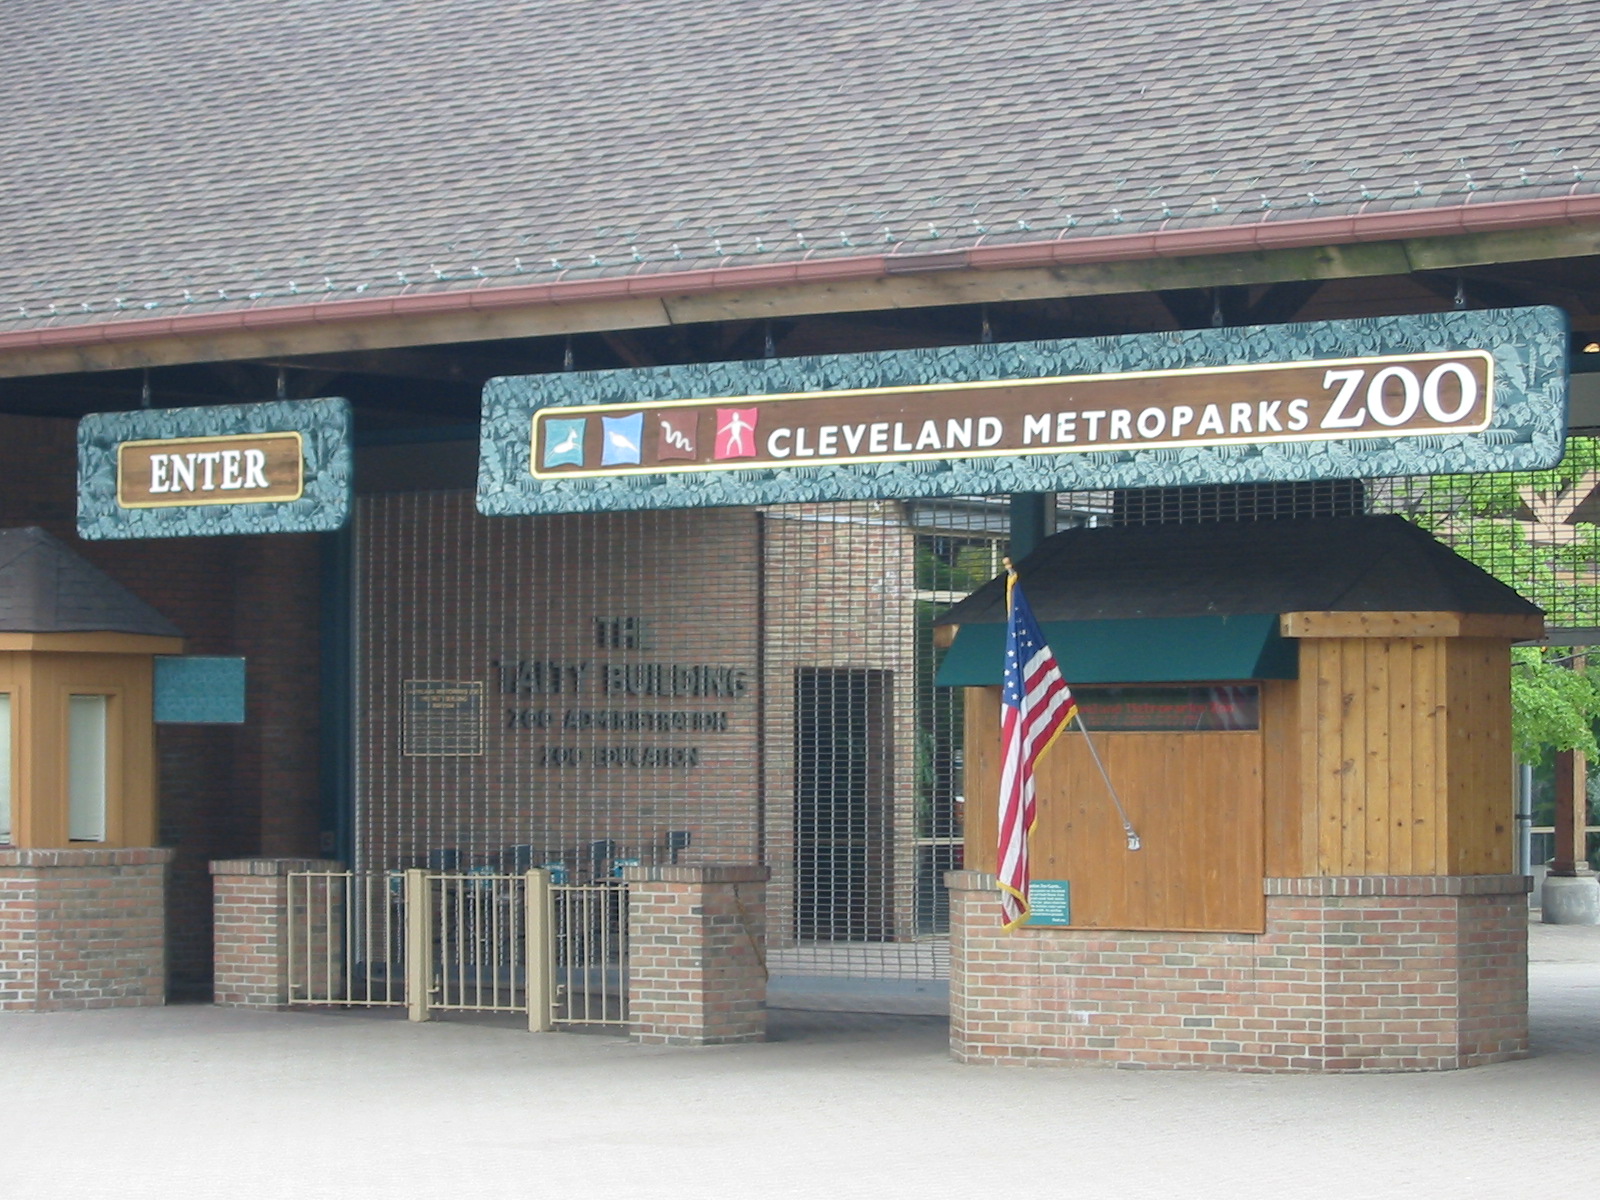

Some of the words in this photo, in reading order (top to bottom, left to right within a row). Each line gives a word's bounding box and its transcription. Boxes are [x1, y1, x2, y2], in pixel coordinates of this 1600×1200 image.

[767, 417, 1003, 458] CLEVELAND
[1023, 398, 1309, 445] METROPARKS
[1321, 363, 1477, 429] ZOO
[149, 449, 270, 494] ENTER
[595, 616, 655, 649] THE
[604, 664, 747, 698] BUILDING
[506, 708, 552, 730] ZOO
[563, 710, 728, 731] ADMINISTRATION
[541, 745, 583, 767] ZOO
[595, 746, 698, 768] EDUCATION
